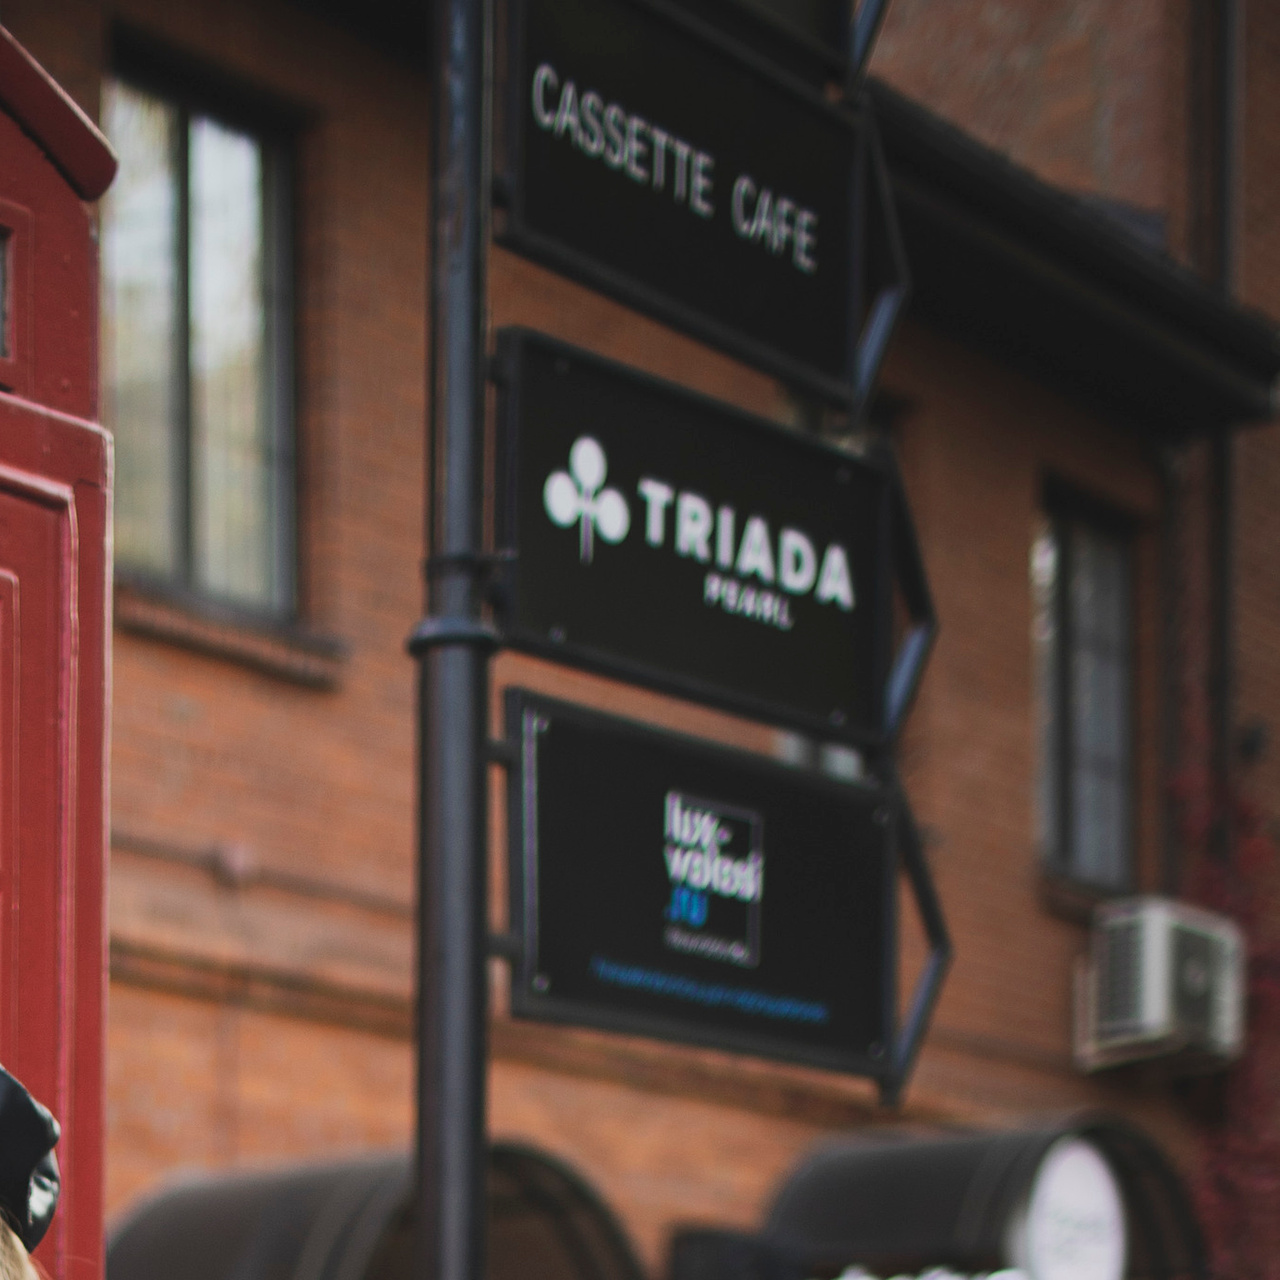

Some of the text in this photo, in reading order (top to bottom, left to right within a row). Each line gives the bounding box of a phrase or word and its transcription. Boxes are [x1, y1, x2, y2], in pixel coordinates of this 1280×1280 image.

[532, 63, 818, 274] CASSETTE CAFE
[638, 477, 855, 612] TRIADA
